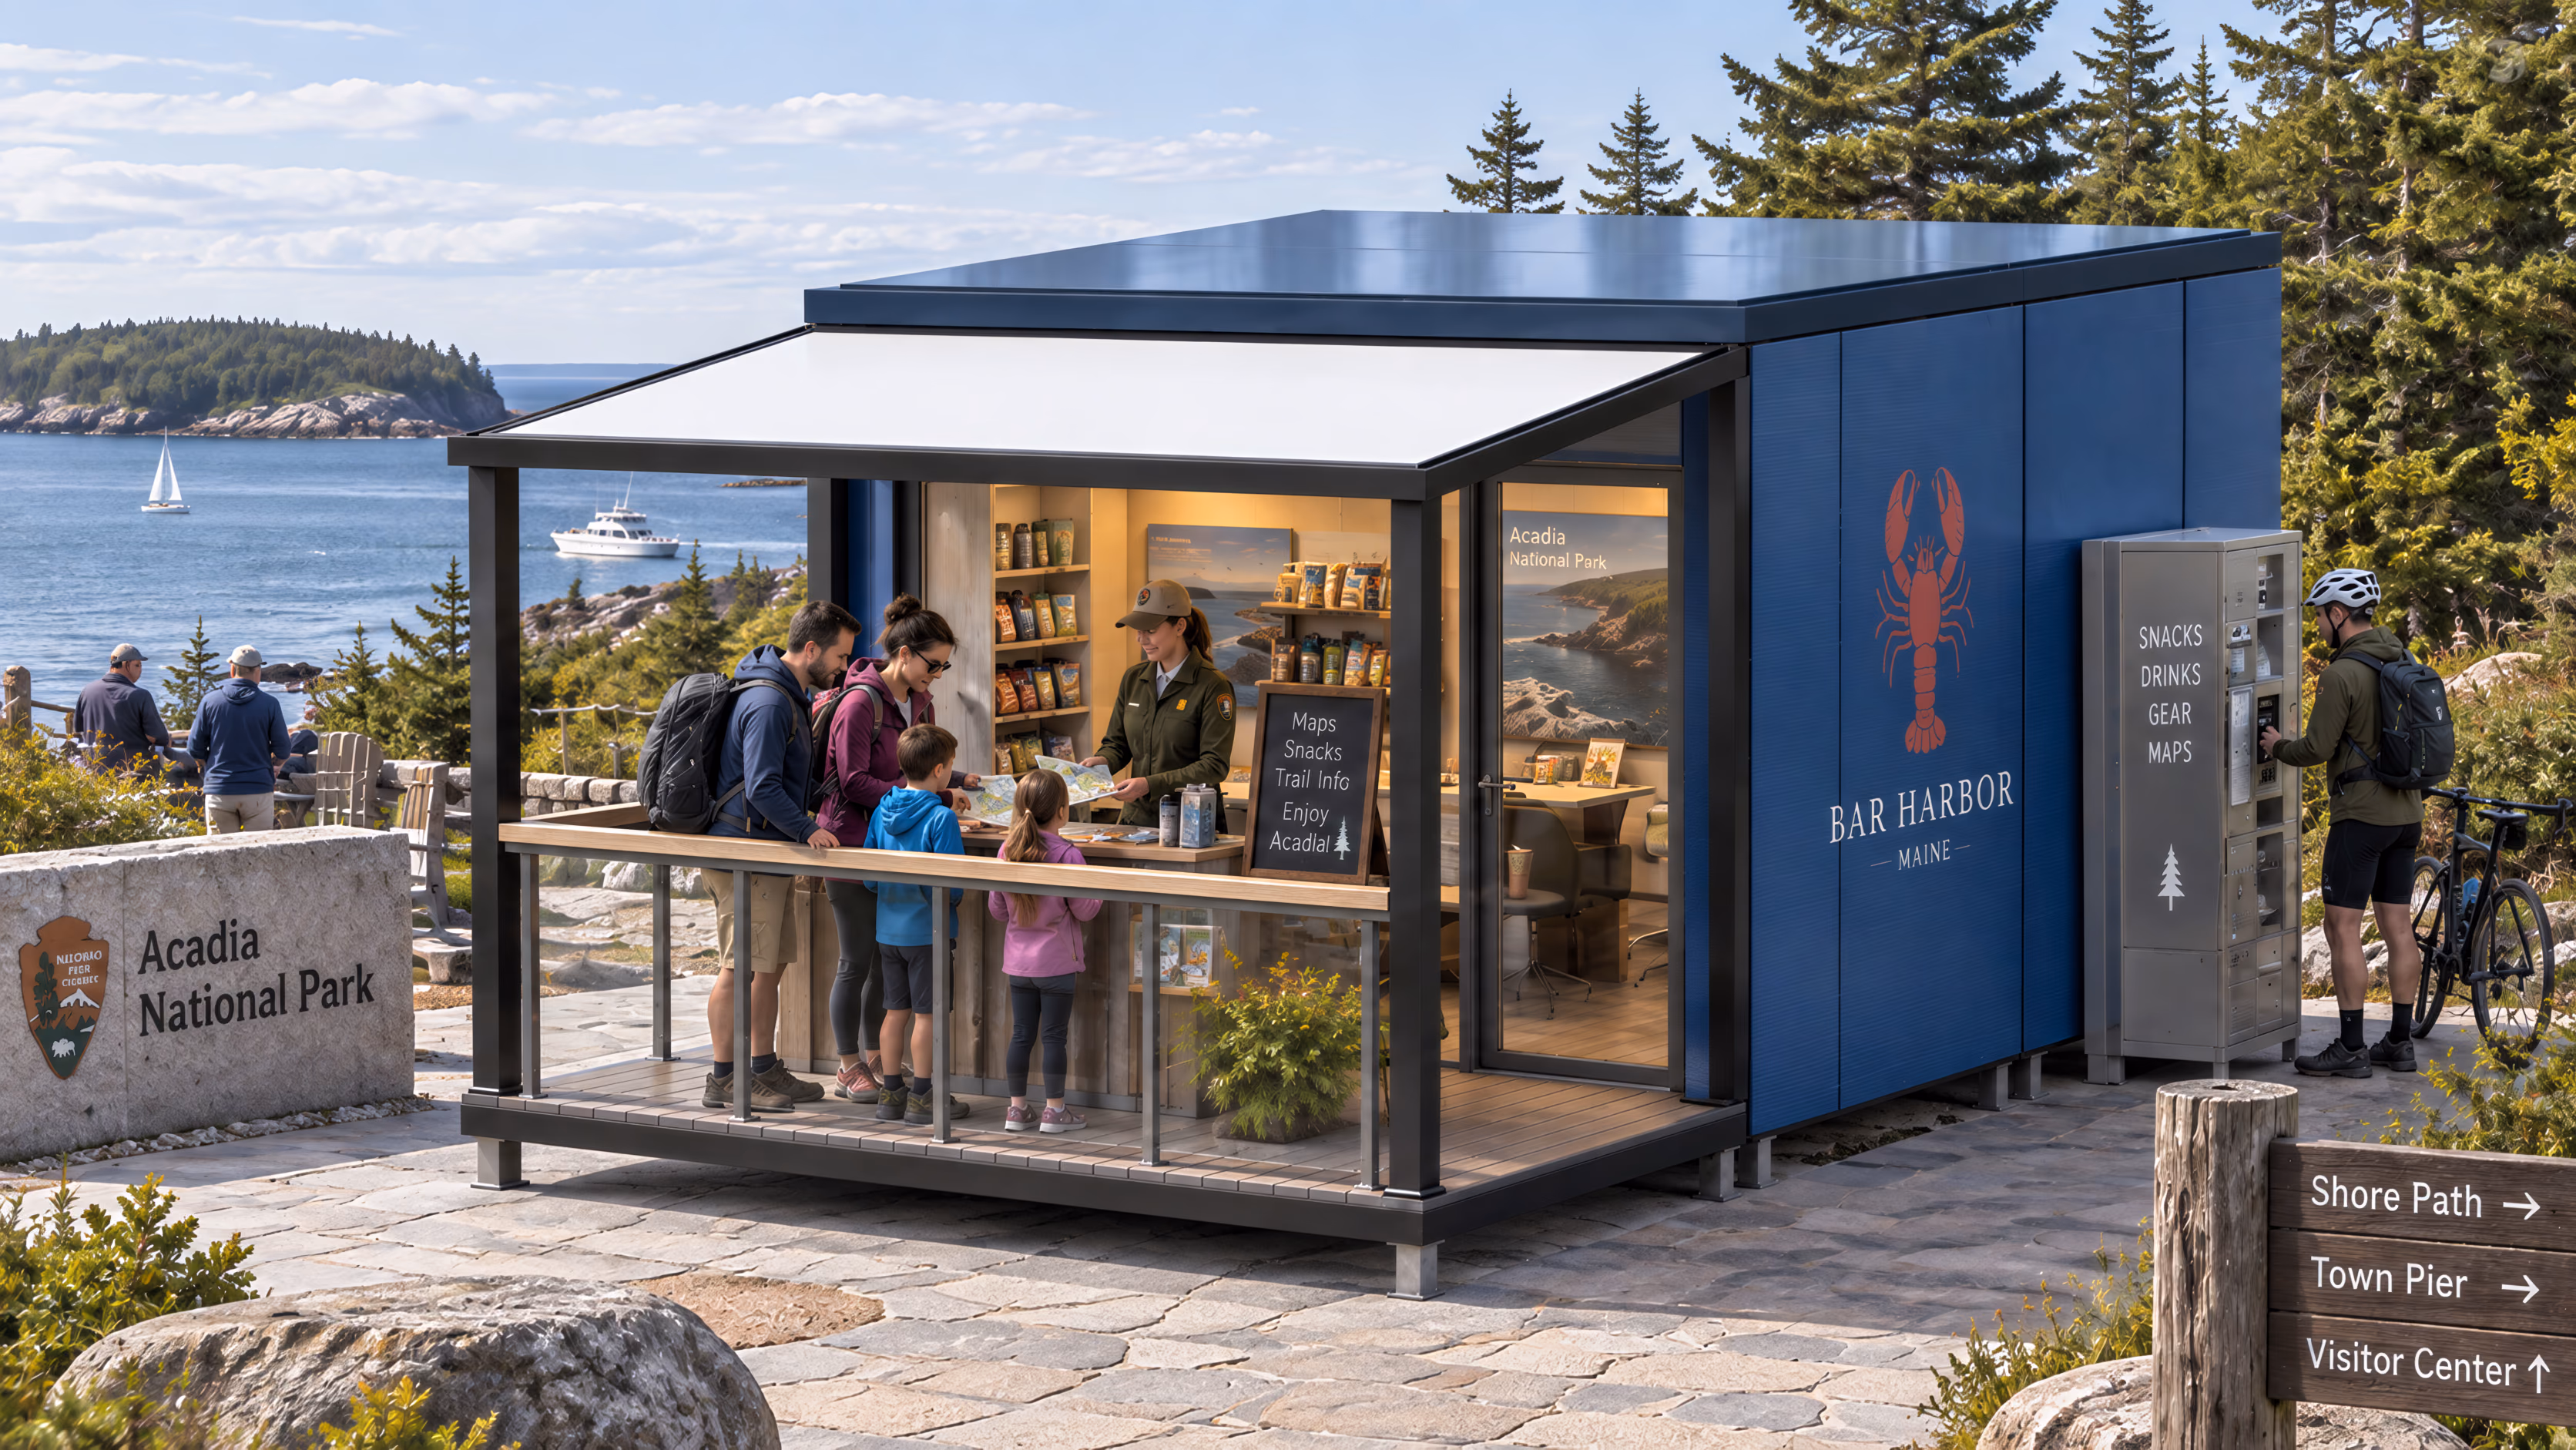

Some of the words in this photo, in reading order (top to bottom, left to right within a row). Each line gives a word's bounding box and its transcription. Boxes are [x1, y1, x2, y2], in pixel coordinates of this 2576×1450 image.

[1509, 526, 1565, 545] Acadia
[1510, 551, 1569, 568] National
[1575, 553, 1607, 570] Park
[2139, 623, 2202, 649] SNACKS
[2142, 663, 2201, 687] DRINKS
[1292, 712, 1337, 737] Maps
[2148, 702, 2192, 726] GEAR
[1284, 739, 1342, 761] Snacks
[2148, 740, 2192, 764] MAPS
[1275, 767, 1310, 788] Trail
[1318, 770, 1350, 790] Info
[1283, 801, 1330, 827] Enjoy
[1830, 797, 1887, 844] BAR
[1897, 770, 2014, 828] HARBOR
[1898, 839, 1950, 871] MAINE
[137, 918, 260, 975] Acadia
[139, 972, 288, 1037] National
[298, 963, 374, 1012] Park
[2311, 1174, 2400, 1211] Shore
[2413, 1181, 2482, 1218] Path
[2310, 1256, 2393, 1293] Town
[2407, 1262, 2468, 1298] Pier
[2306, 1338, 2404, 1376] Visitor
[2414, 1347, 2517, 1386] Center
